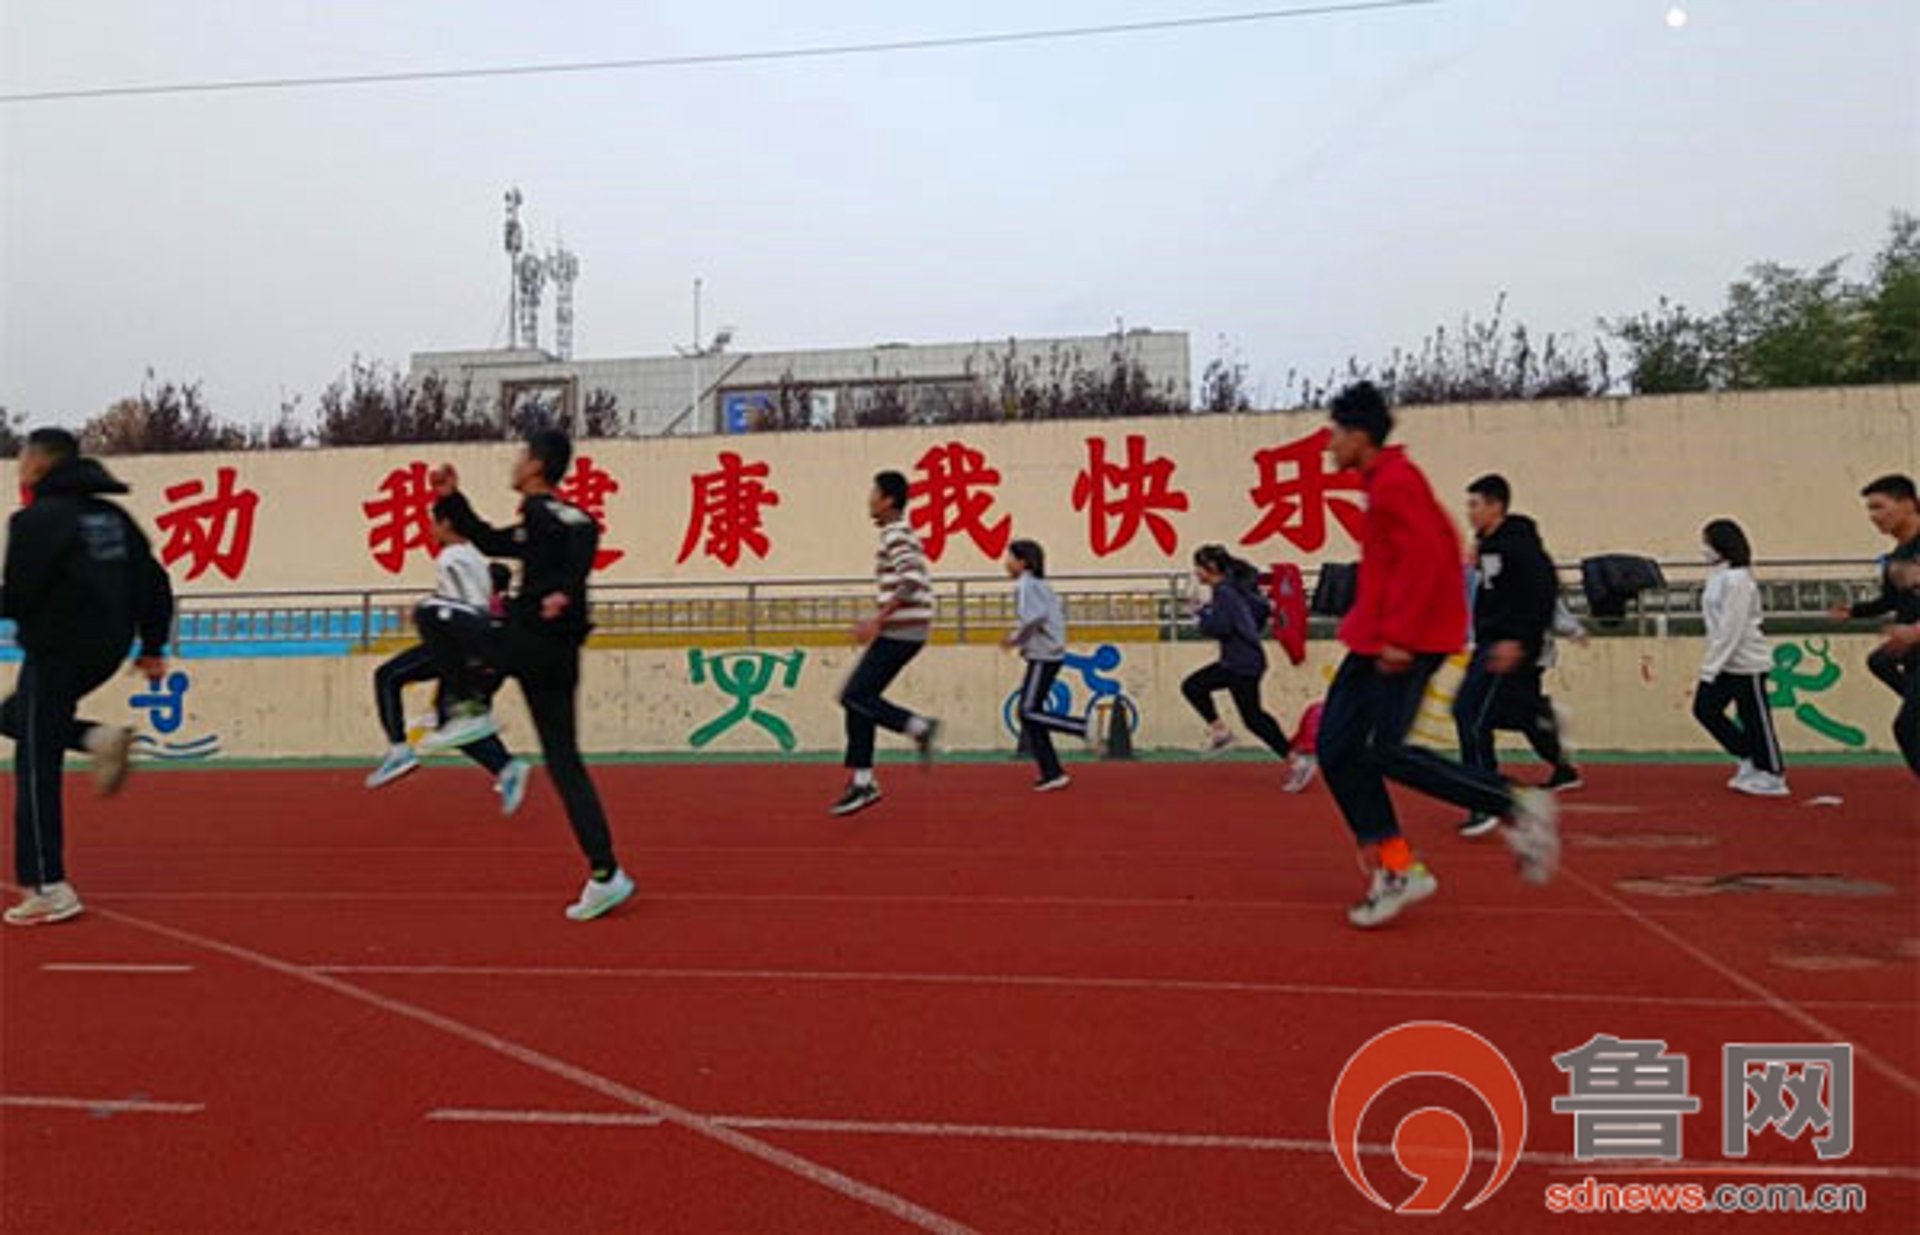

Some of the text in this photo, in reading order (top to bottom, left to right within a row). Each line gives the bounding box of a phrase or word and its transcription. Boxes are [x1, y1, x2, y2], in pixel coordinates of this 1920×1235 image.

[155, 466, 260, 582] 动
[905, 426, 1367, 562] 我快乐
